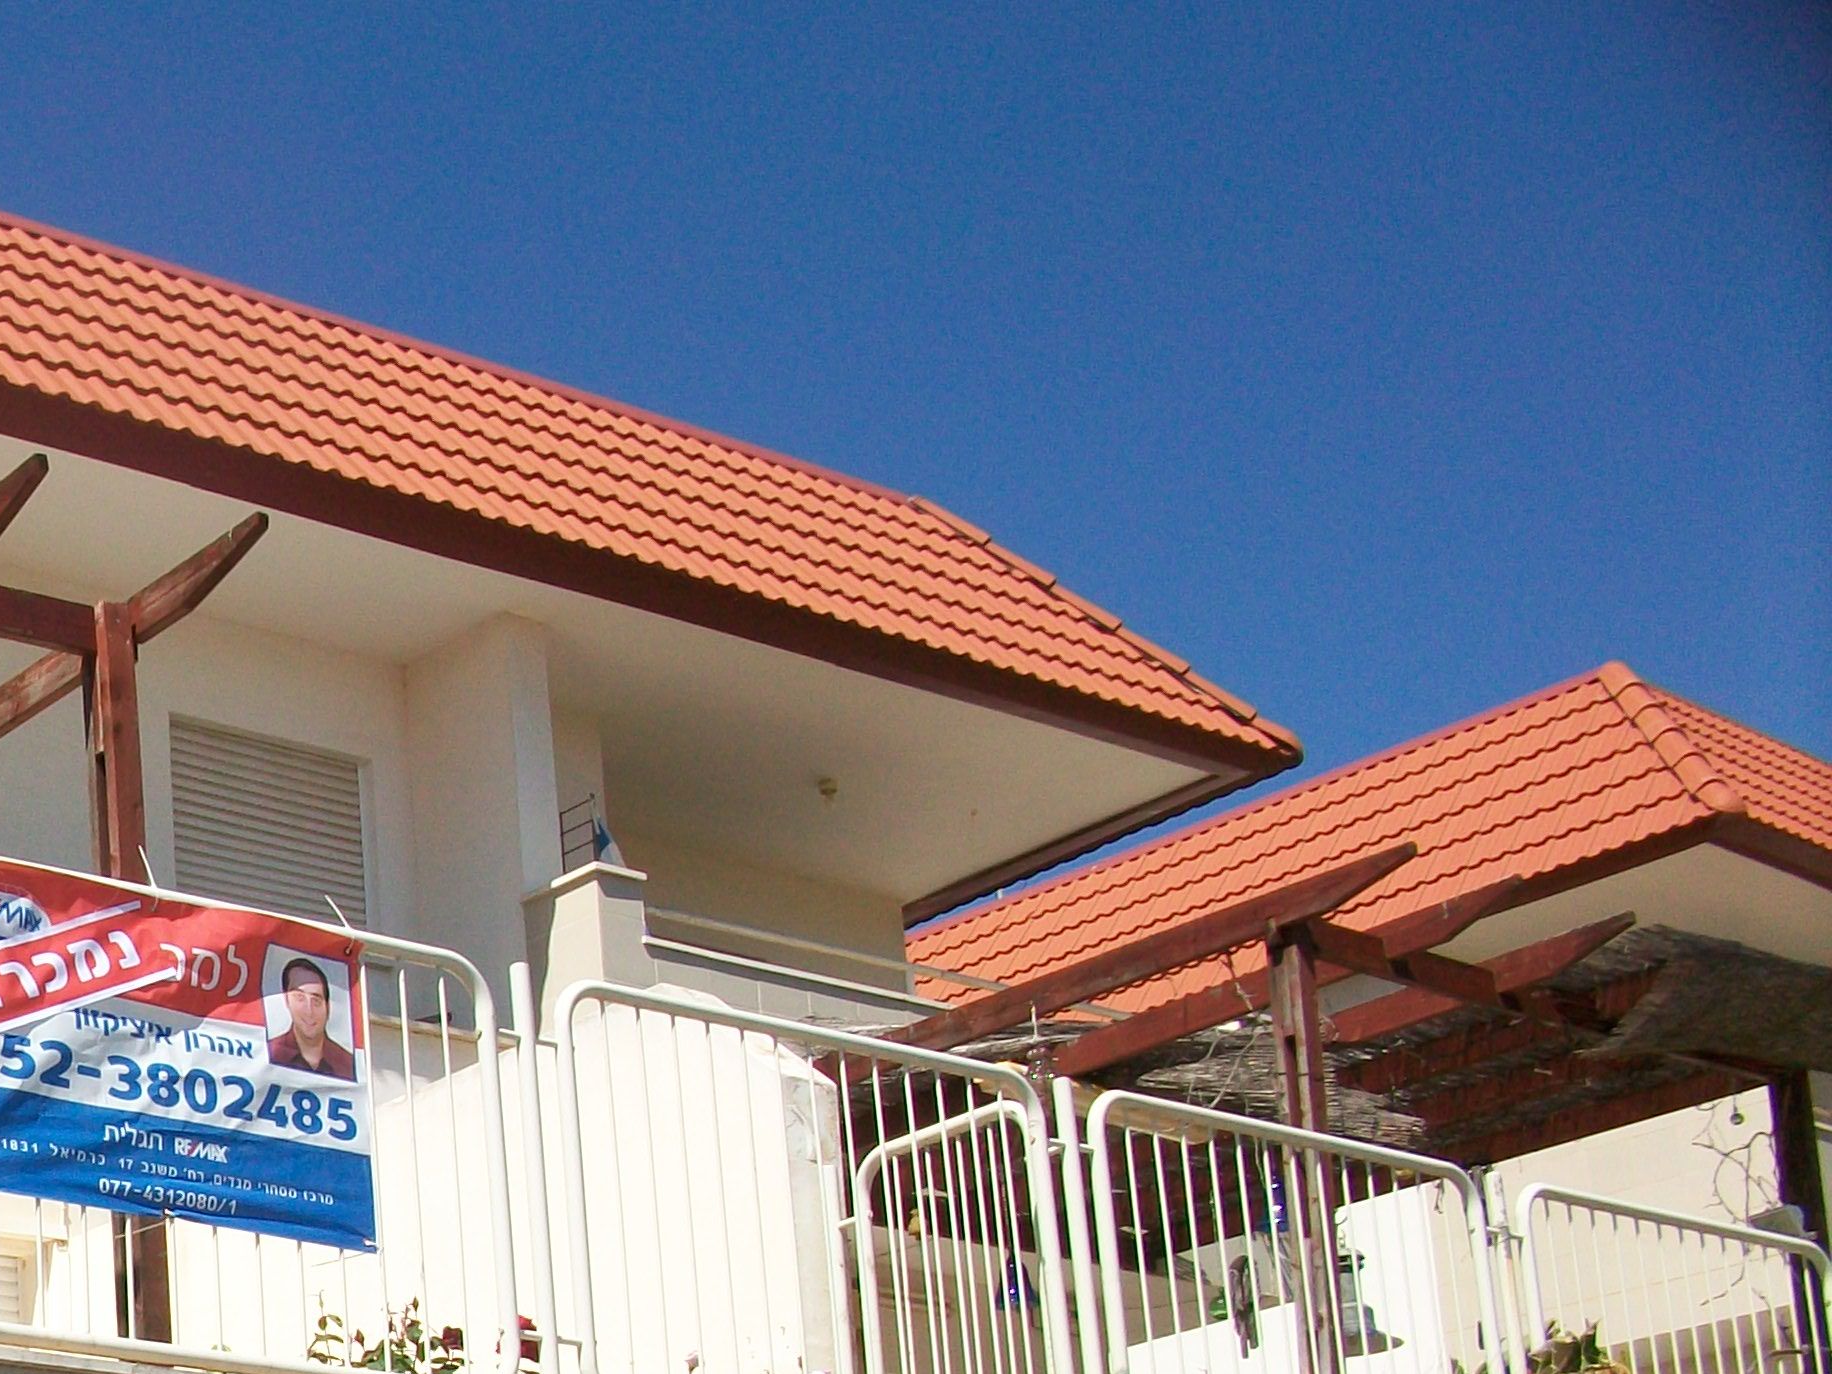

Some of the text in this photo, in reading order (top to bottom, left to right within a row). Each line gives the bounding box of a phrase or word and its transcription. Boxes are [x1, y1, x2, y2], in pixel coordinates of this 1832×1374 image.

[73, 1007, 254, 1059] אהרון איציקזון
[103, 1120, 164, 1151] תגלית
[48, 1142, 107, 1166] כרמיאל
[118, 1157, 134, 1171] 17
[99, 1177, 237, 1216] 077-4312080/1
[257, 1182, 298, 1199] מסחרי
[302, 1190, 335, 1206] מרכז
